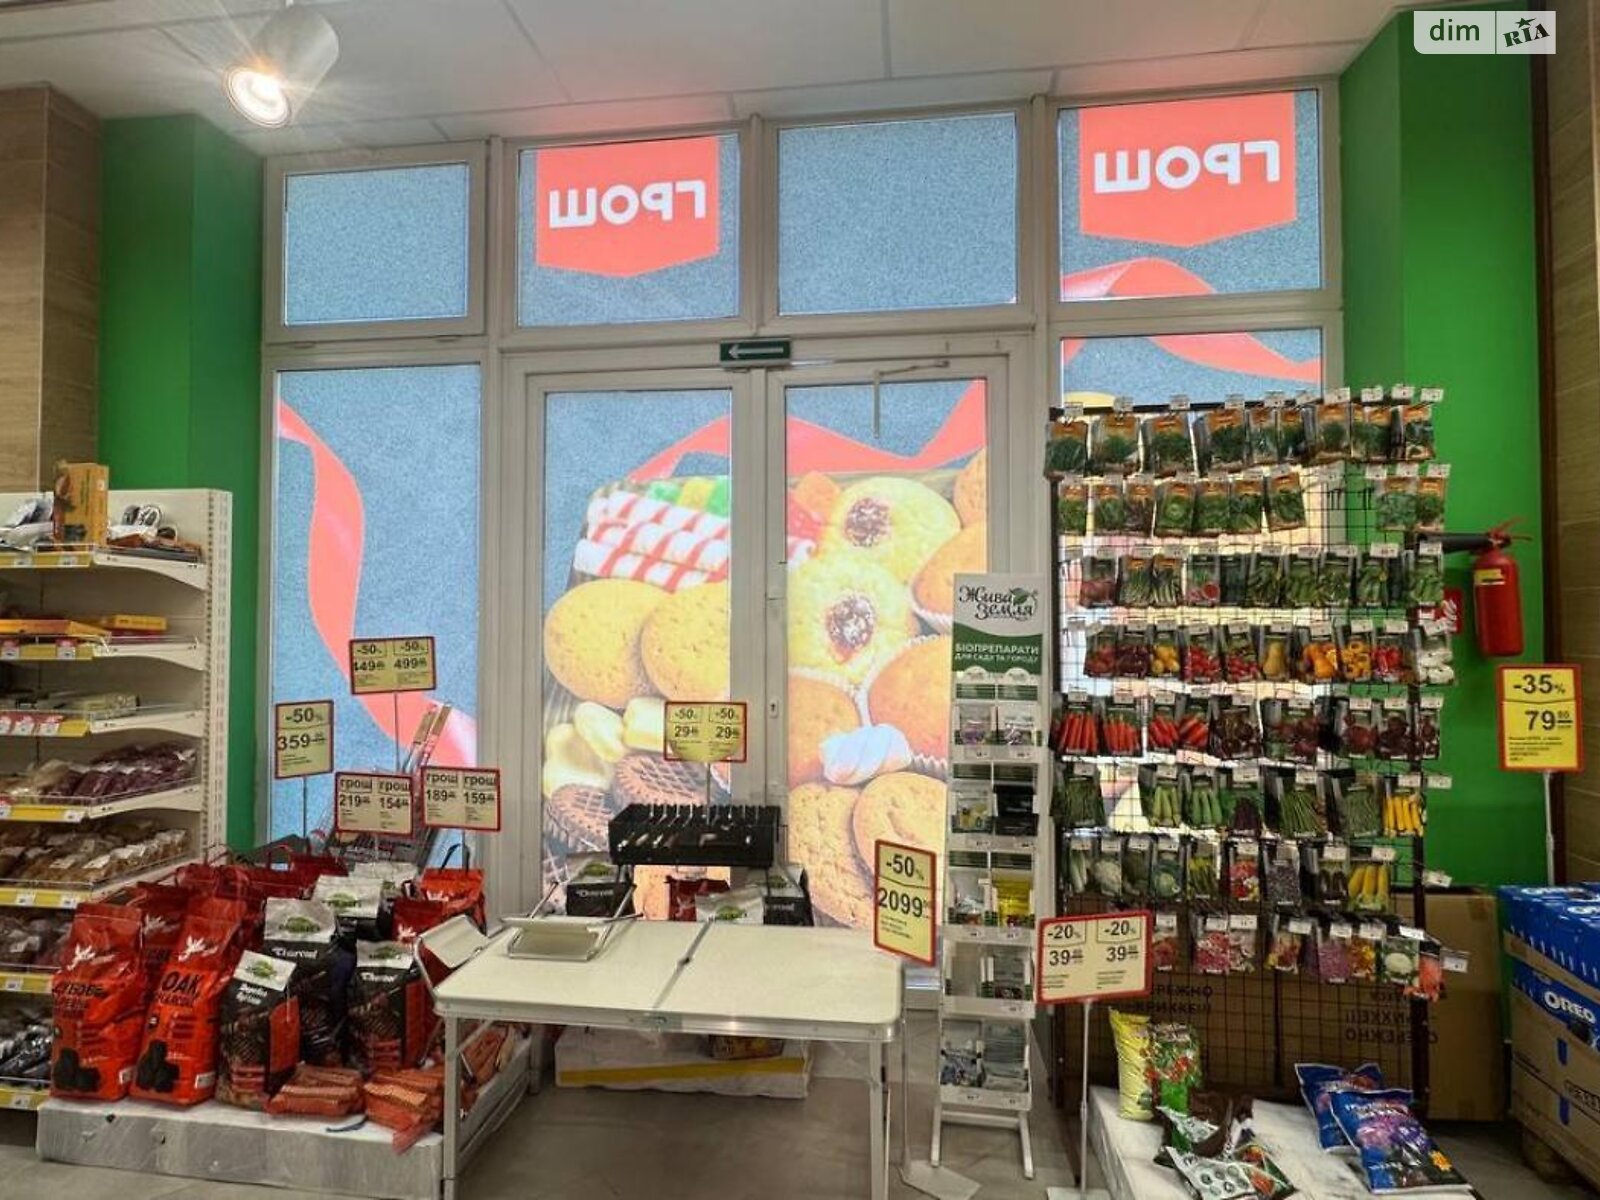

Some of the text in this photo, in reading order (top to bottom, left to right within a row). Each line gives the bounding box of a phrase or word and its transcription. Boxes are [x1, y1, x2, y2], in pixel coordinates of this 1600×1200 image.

[959, 585, 1013, 603] Жива
[1513, 674, 1566, 694] -35%
[1525, 710, 1555, 731] 79
[277, 734, 310, 751] 359
[878, 887, 923, 918] 2099
[1049, 949, 1070, 966] 39
[1106, 946, 1127, 962] 39
[1544, 991, 1596, 1024] OREO
